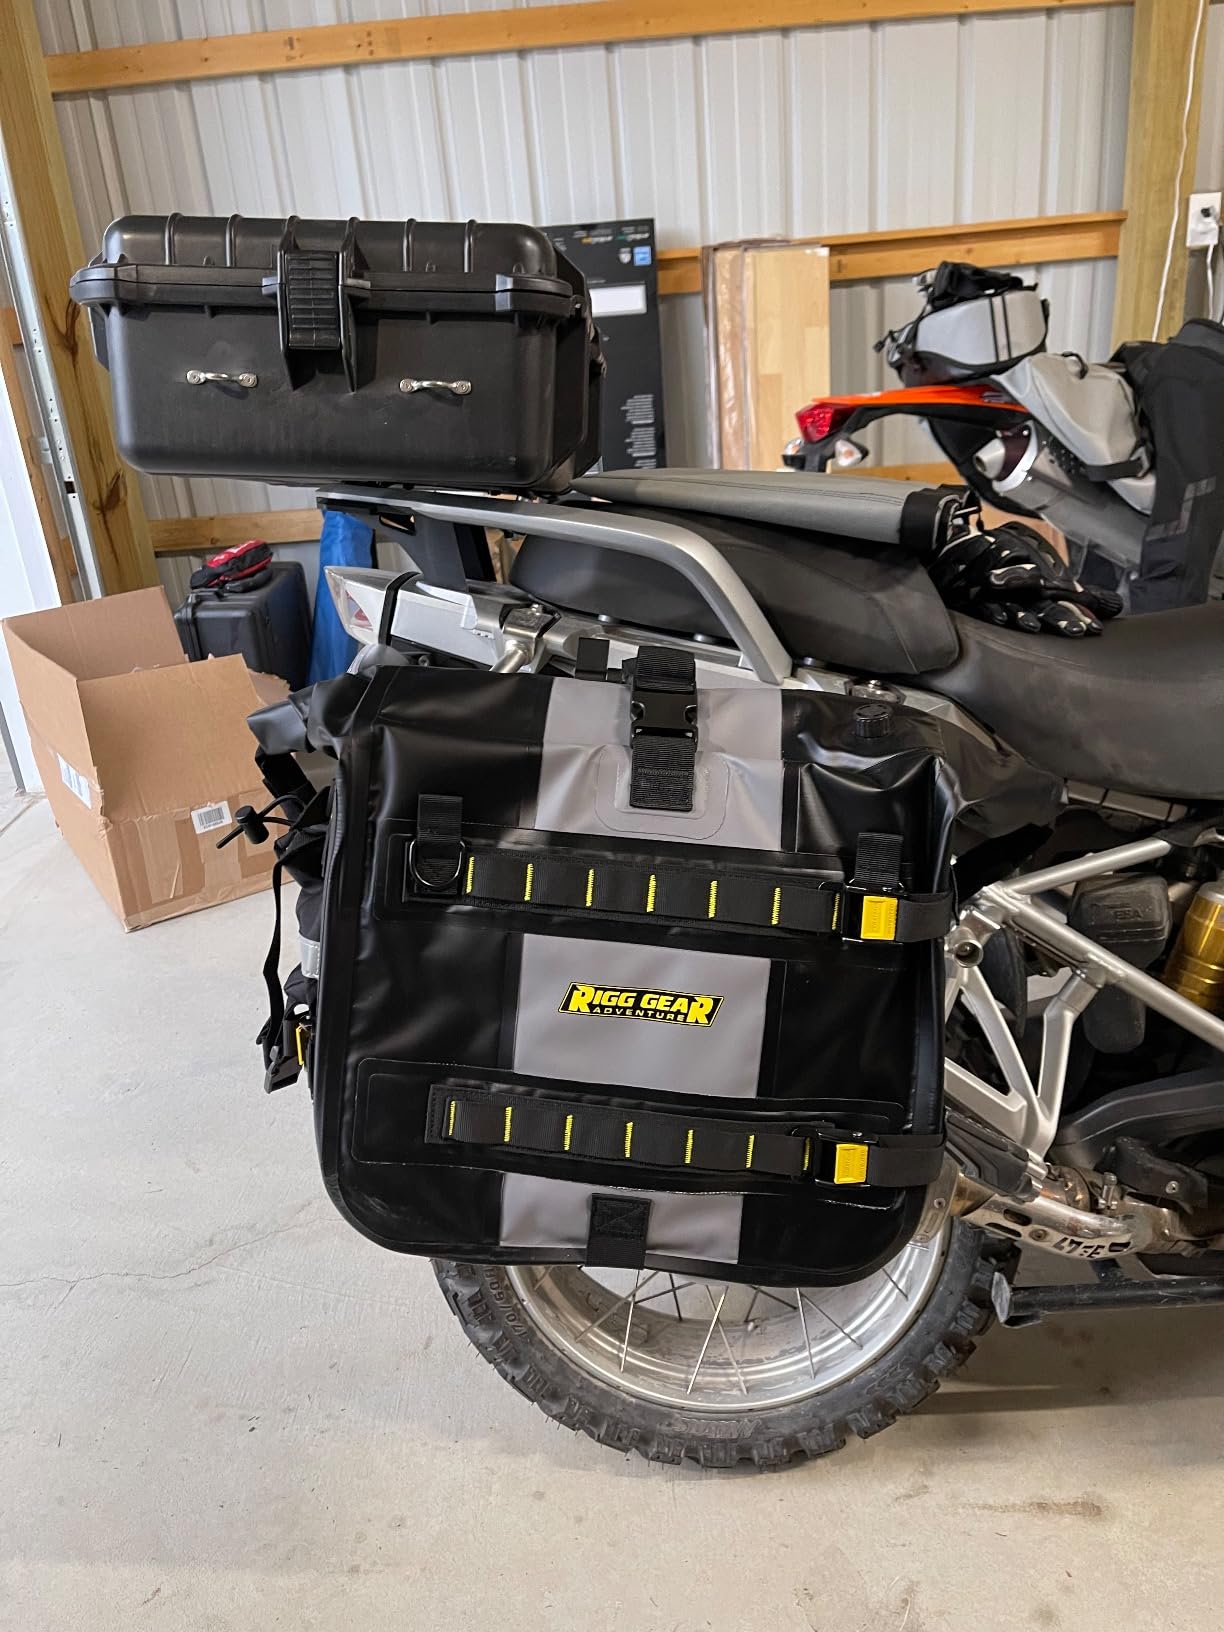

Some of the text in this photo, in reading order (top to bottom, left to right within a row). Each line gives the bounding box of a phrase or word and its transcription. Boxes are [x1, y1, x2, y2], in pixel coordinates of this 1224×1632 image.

[568, 984, 714, 1024] RIGG GEAR
[592, 1006, 686, 1022] ADVENTURE
